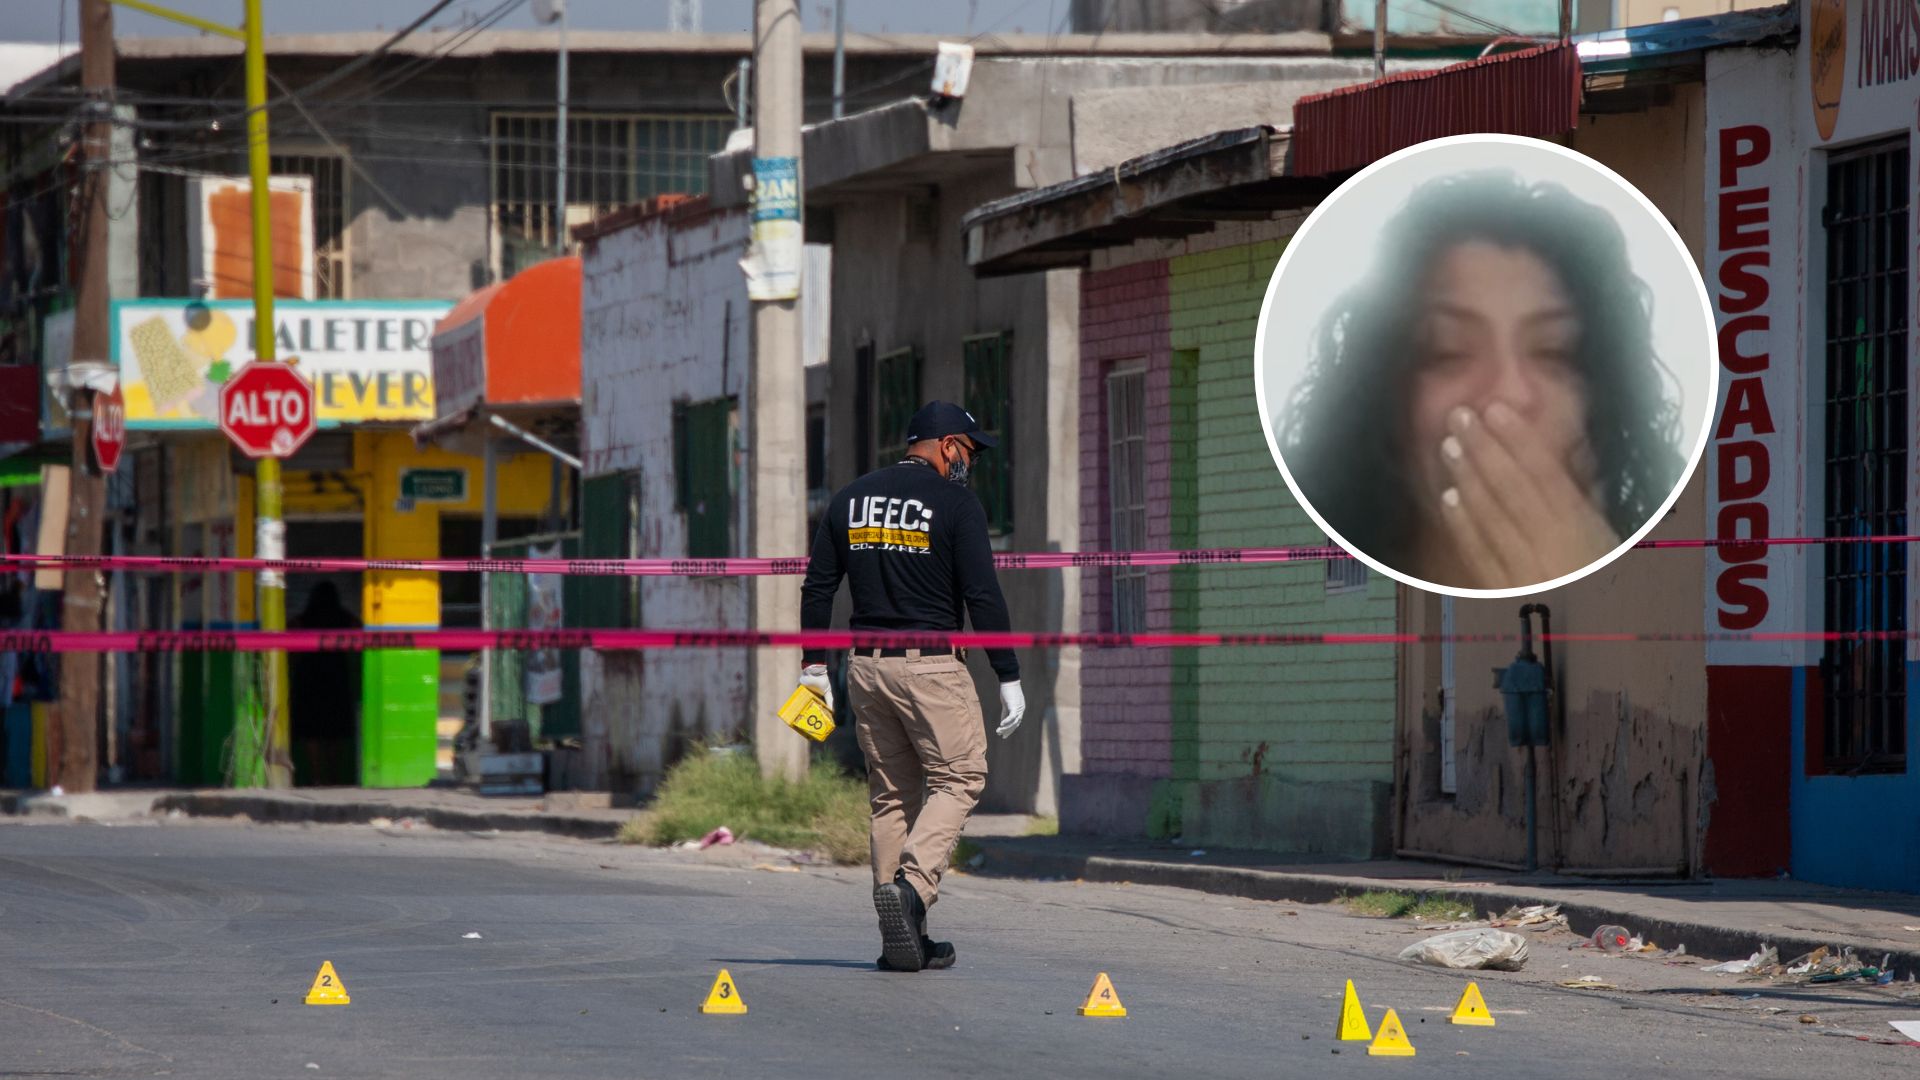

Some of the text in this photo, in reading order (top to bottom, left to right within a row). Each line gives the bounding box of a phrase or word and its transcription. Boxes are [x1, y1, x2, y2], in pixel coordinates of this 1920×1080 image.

[247, 318, 441, 351] ALETER
[312, 370, 432, 409] EVER
[1715, 125, 1775, 630] PESCADOS
[228, 389, 305, 426] ALTO
[95, 403, 124, 442] ALTO
[806, 714, 823, 730] 8
[321, 974, 332, 987] 2
[719, 981, 730, 999] 3
[1100, 987, 1112, 1000] 4
[1347, 1004, 1360, 1030] 6
